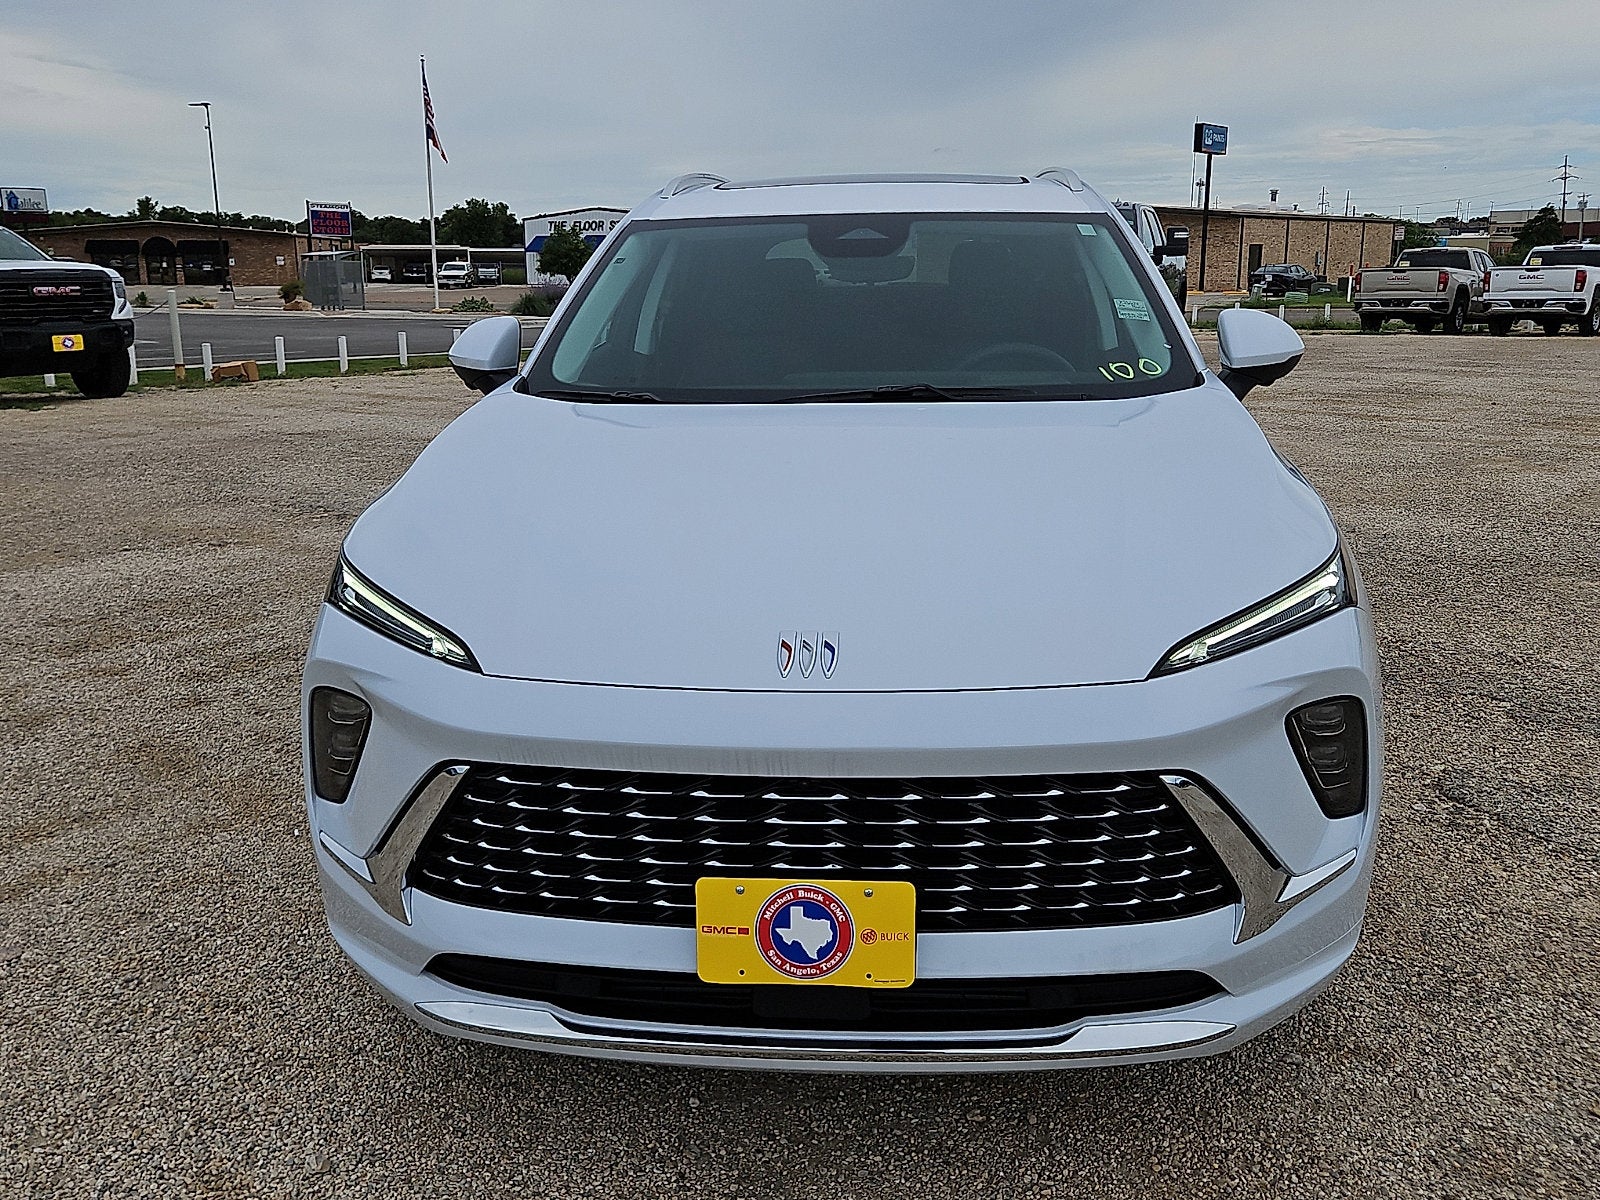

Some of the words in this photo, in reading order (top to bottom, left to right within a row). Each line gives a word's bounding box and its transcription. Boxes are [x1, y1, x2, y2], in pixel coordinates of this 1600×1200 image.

[318, 211, 341, 219] THE
[313, 219, 348, 227] FLOOR
[548, 220, 567, 231] THE
[573, 220, 605, 231] FLOOR
[313, 226, 348, 234] STORE
[33, 286, 81, 297] GMC
[1097, 357, 1163, 382] 100
[763, 892, 795, 921] Mitchell
[798, 890, 824, 902] Buick
[830, 903, 846, 923] GMC
[701, 925, 737, 935] GMC
[880, 932, 910, 941] BUICK
[767, 949, 782, 967] San
[783, 962, 821, 976] Angelo,
[820, 950, 843, 971] Texas
